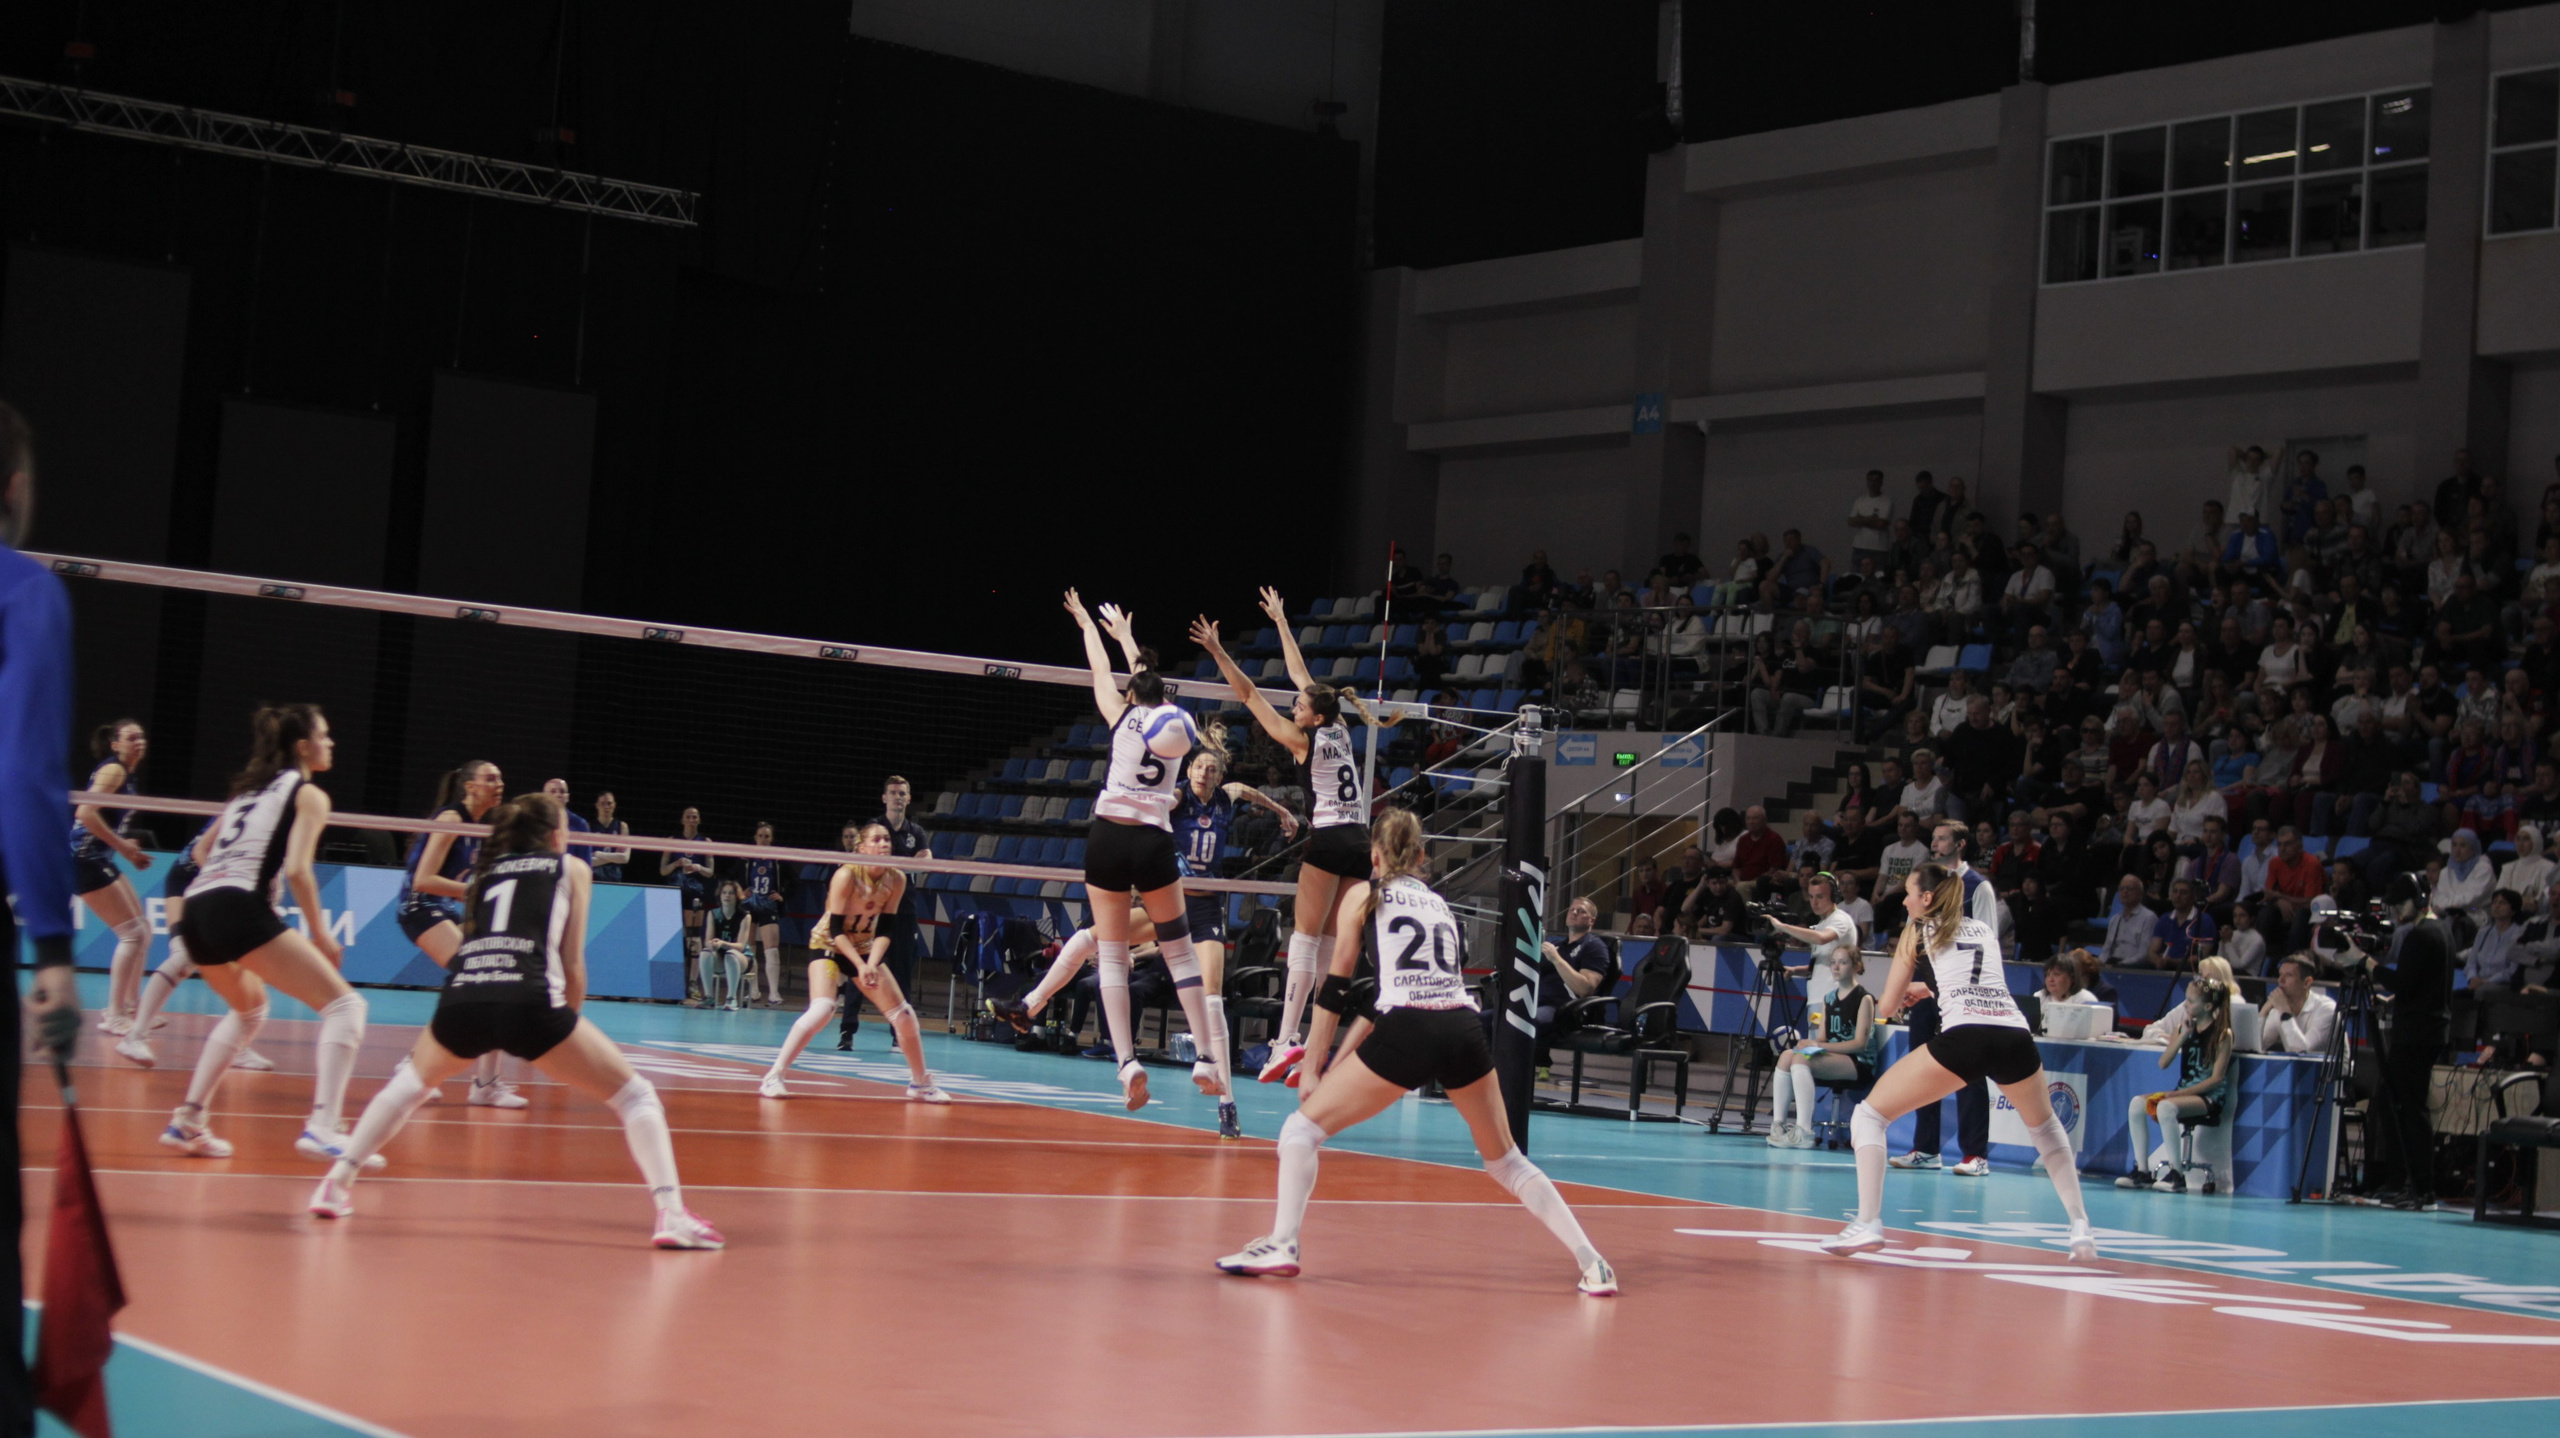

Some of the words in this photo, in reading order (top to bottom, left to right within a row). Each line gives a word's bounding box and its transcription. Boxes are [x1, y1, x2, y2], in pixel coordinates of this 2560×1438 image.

[822, 646, 856, 660] PARI
[987, 665, 1020, 678] PARI
[1165, 684, 1177, 694] RI
[1136, 749, 1165, 787] 5
[1337, 764, 1357, 802] 8
[219, 802, 257, 849] 3
[1187, 830, 1216, 863] 10
[753, 877, 769, 894] 13
[483, 879, 518, 932] 1
[848, 914, 875, 933] 11
[1388, 915, 1460, 975] 20
[1505, 860, 1546, 1040] PARI
[1956, 942, 1984, 985] 7
[1830, 1015, 1841, 1033] 10
[2187, 1047, 2201, 1066] 21
